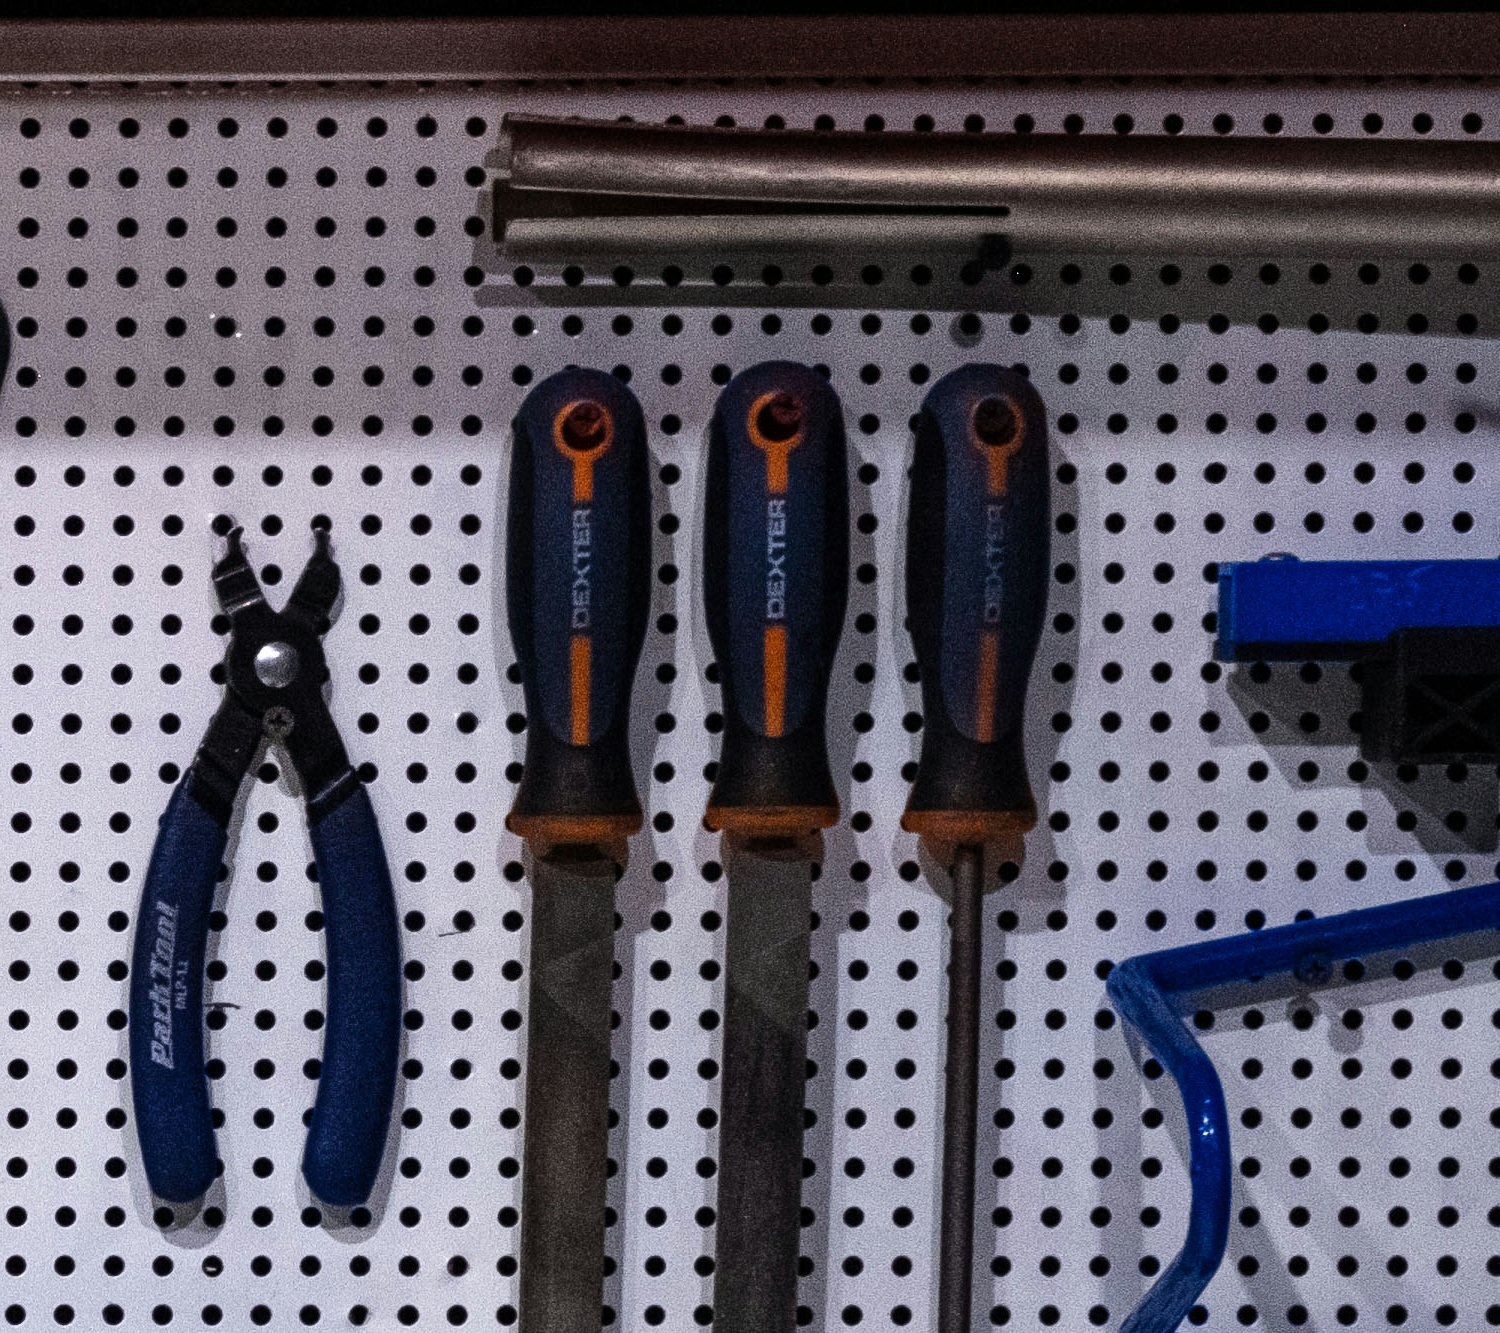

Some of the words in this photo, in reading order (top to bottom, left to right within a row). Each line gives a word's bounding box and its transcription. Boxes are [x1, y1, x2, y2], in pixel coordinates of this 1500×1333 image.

[572, 509, 592, 629] DEXTER
[766, 499, 787, 619] DEXTER
[984, 503, 1004, 625] DEXTER
